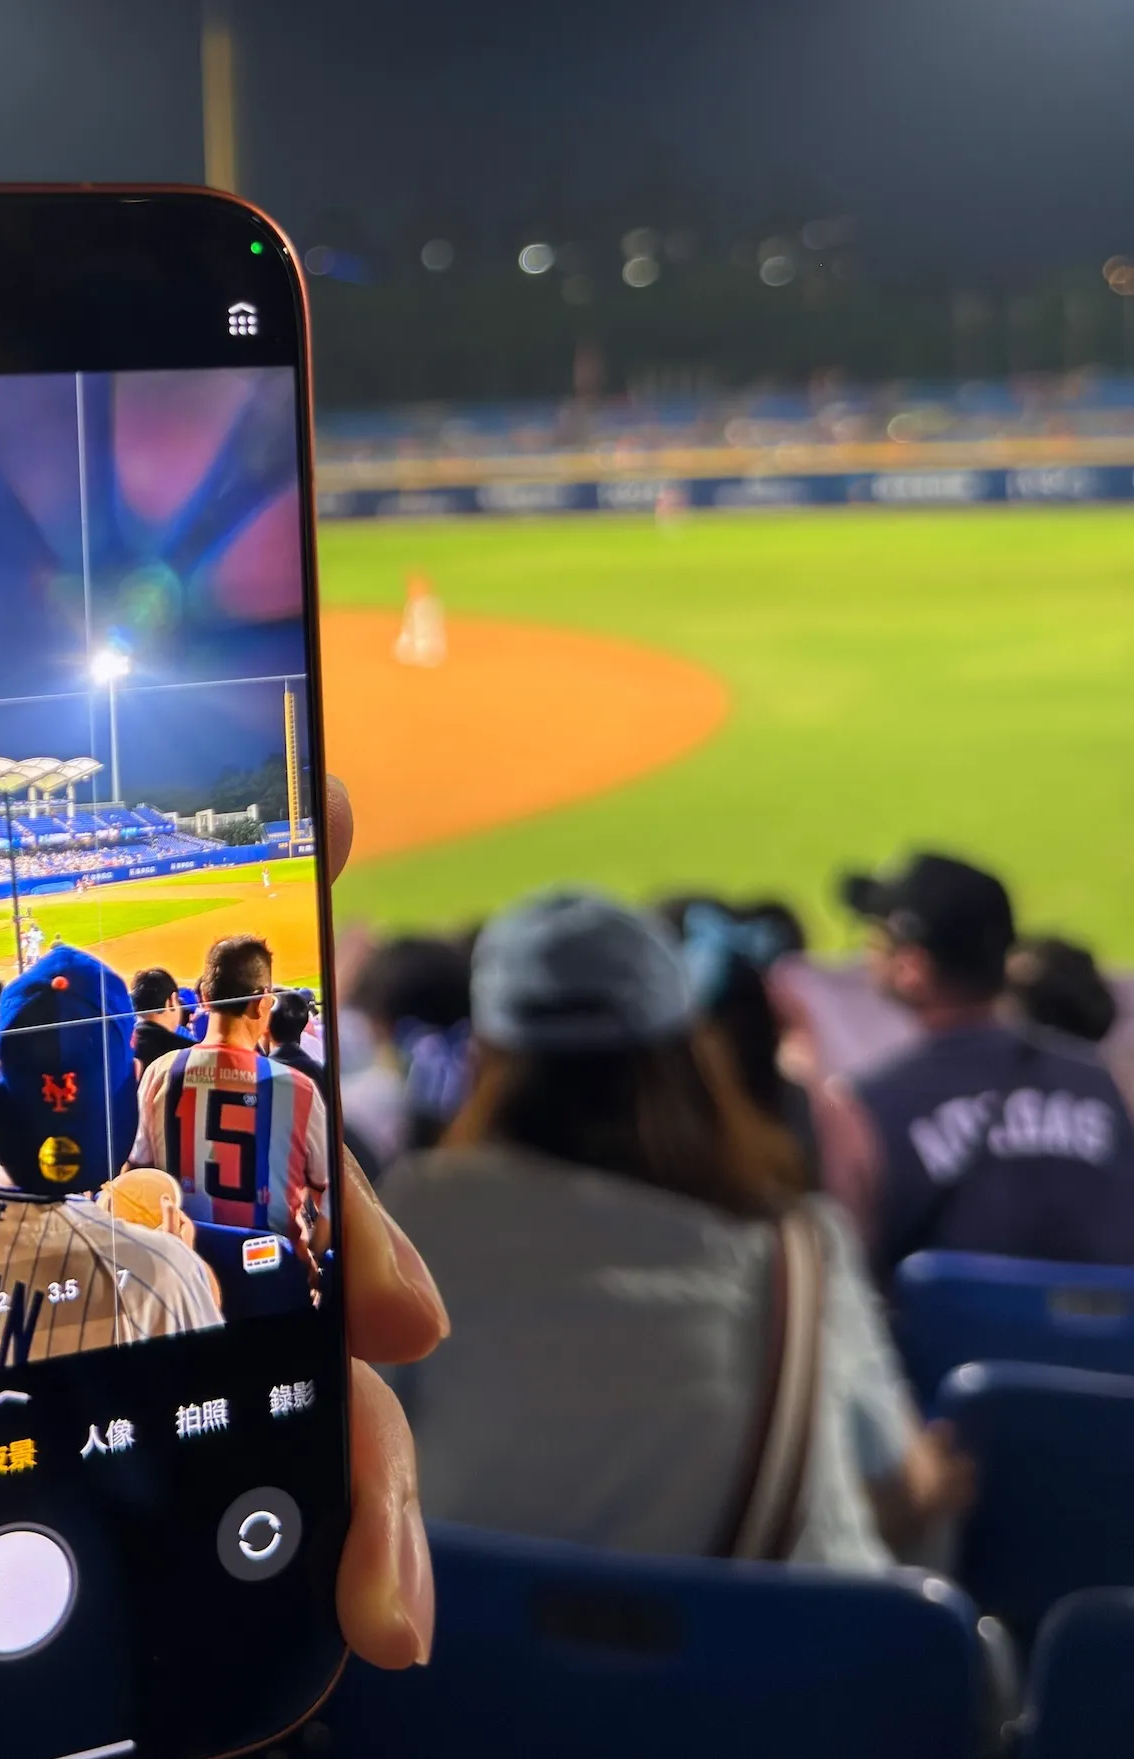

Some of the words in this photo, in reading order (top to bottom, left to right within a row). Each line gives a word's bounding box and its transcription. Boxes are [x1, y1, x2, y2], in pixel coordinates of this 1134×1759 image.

[175, 1085, 257, 1203] 15
[47, 1278, 80, 1303] 3.5
[176, 1397, 230, 1438] 拍照
[269, 1379, 315, 1417] 錄影
[79, 1418, 136, 1458] 人像
